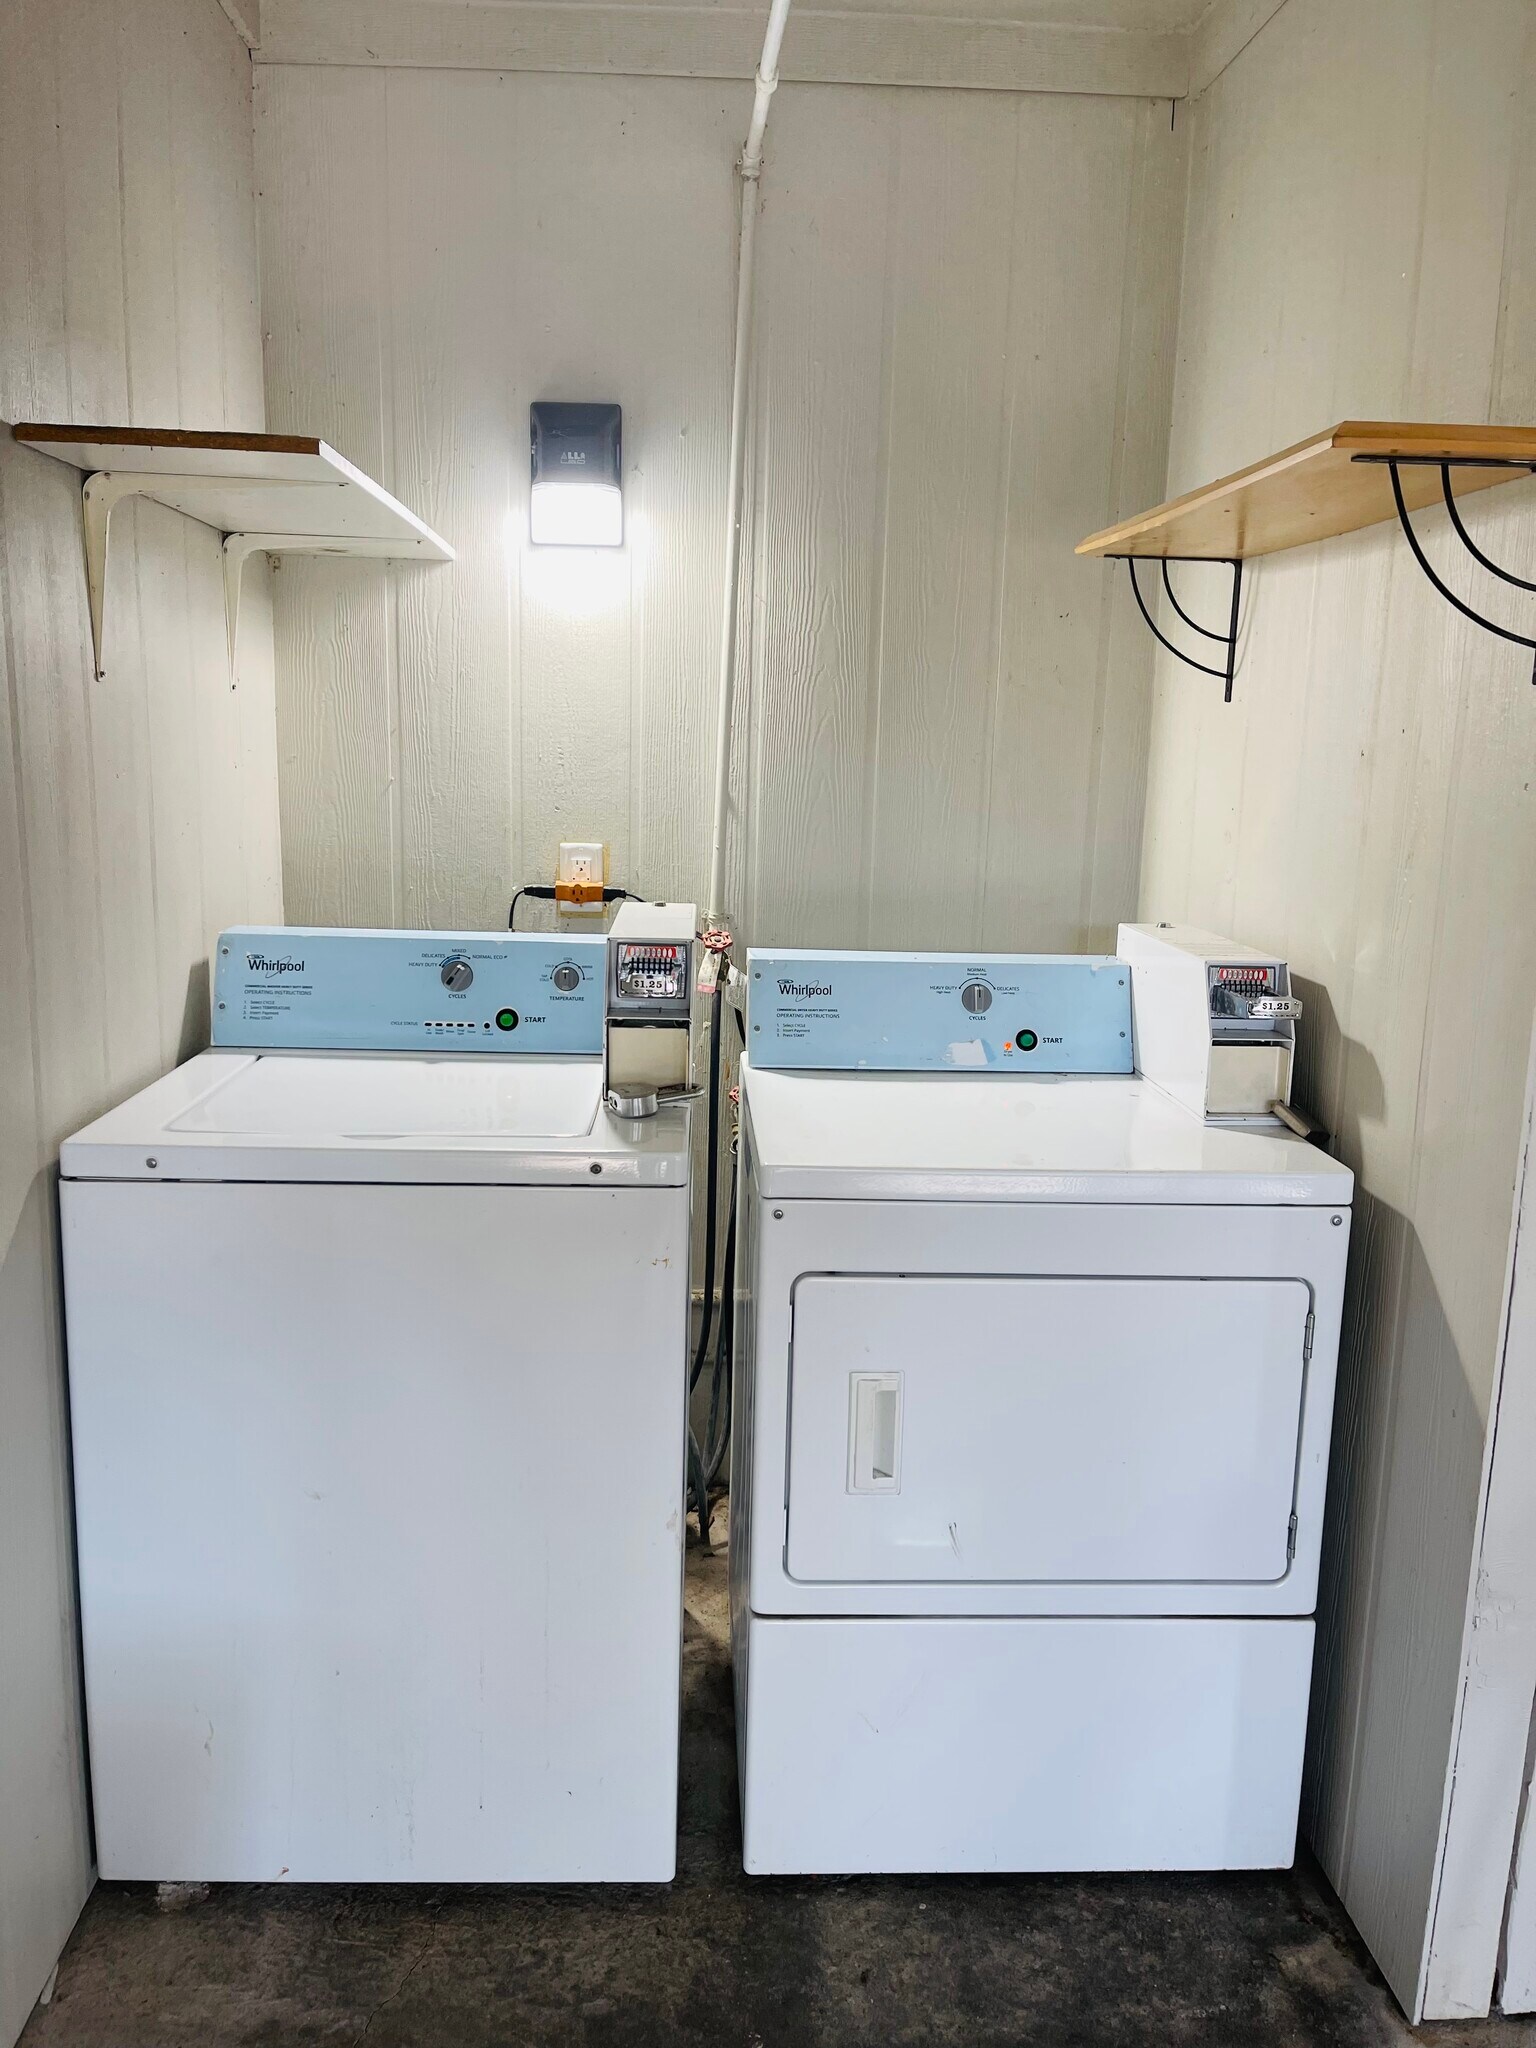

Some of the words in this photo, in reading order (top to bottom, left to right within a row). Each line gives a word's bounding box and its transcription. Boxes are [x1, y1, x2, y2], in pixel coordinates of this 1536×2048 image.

[248, 959, 305, 974] Whirlpool
[634, 980, 663, 989] $1.25
[779, 984, 832, 999] Whirlpool
[1262, 1002, 1290, 1011] $1.25
